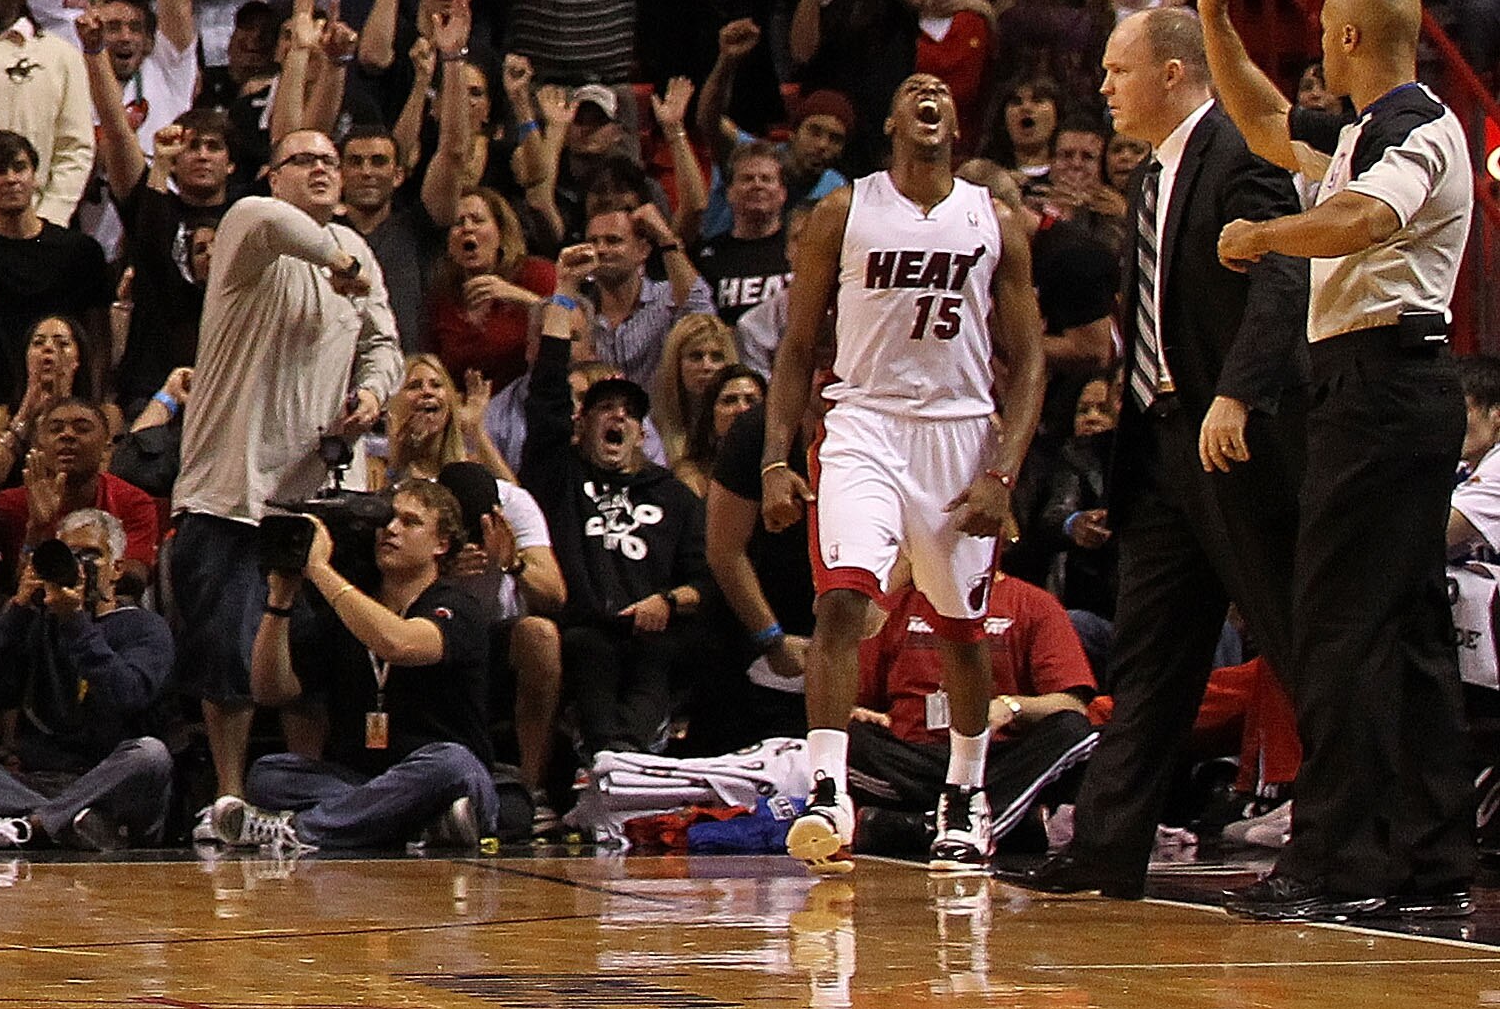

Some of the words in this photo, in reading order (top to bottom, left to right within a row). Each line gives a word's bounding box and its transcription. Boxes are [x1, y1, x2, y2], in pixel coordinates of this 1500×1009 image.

[718, 273, 796, 308] HEA
[864, 244, 987, 292] HEAT
[909, 294, 964, 342] 15
